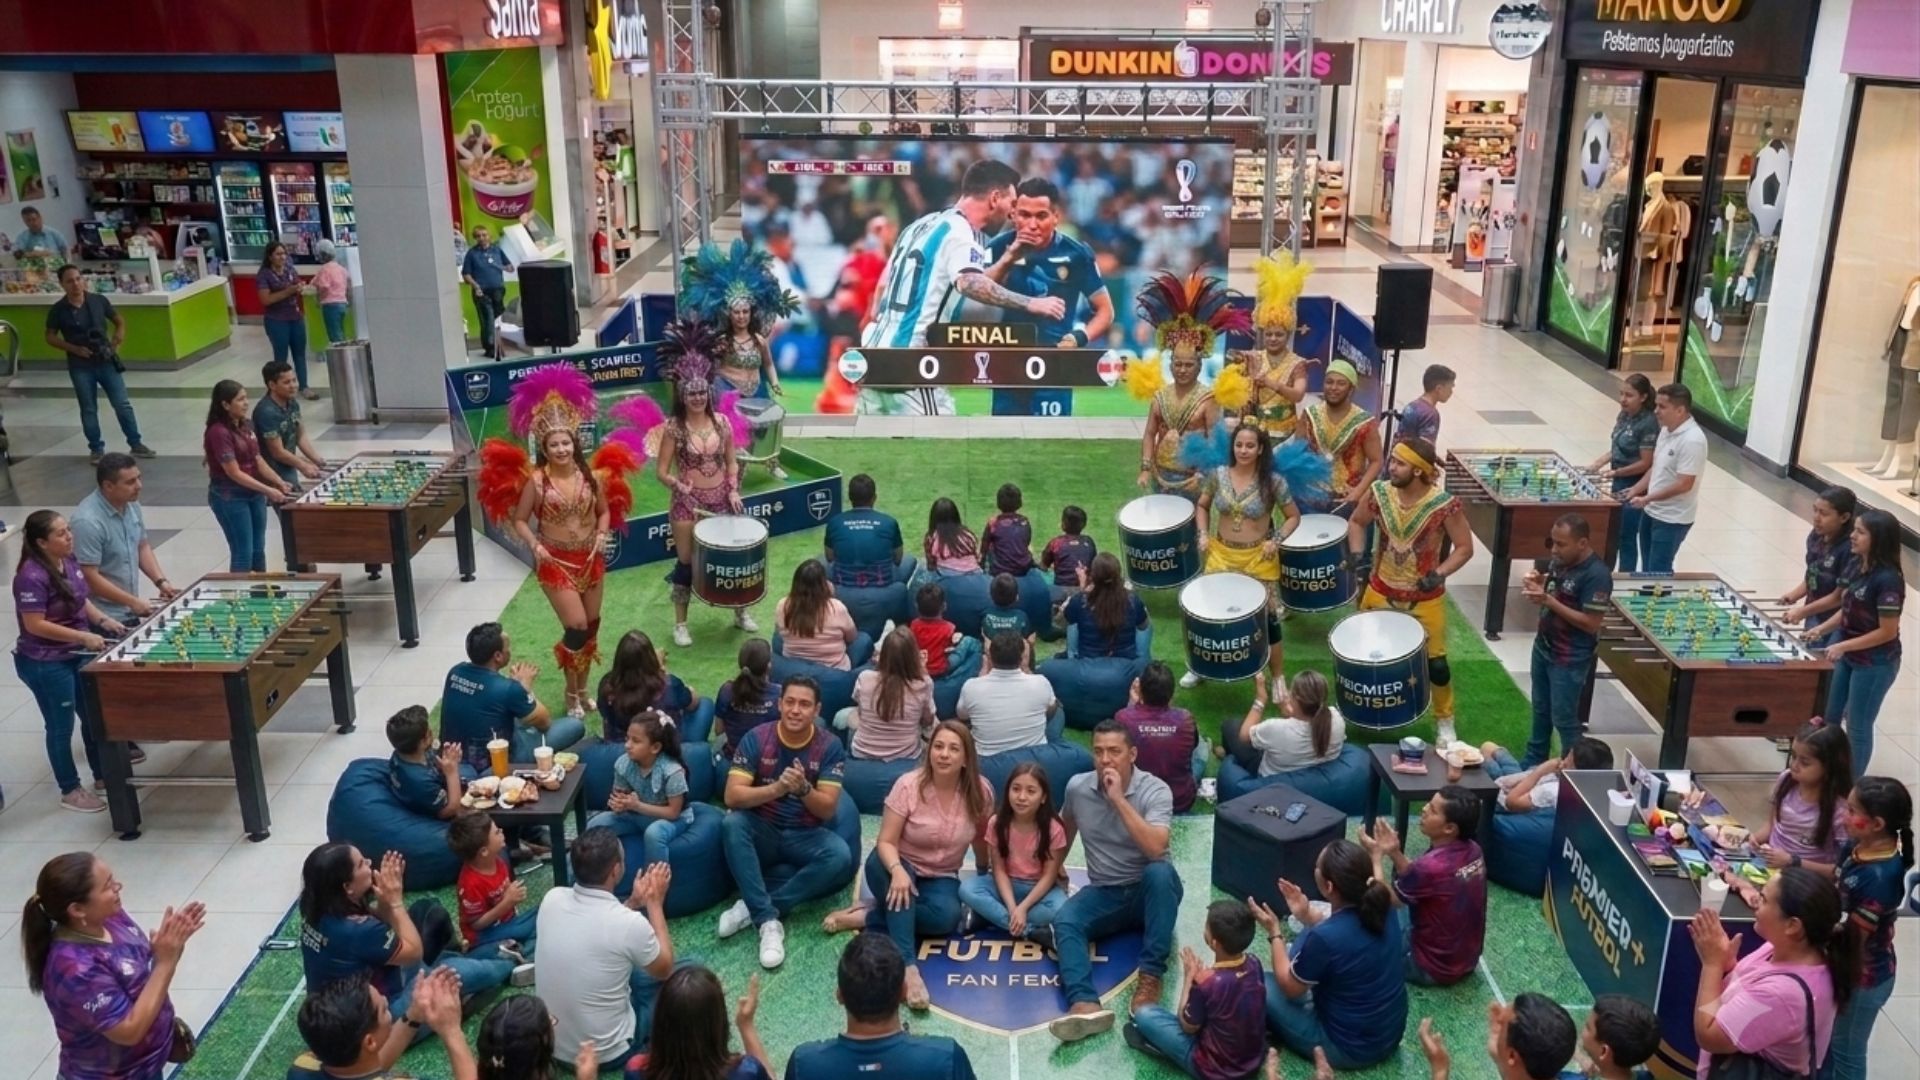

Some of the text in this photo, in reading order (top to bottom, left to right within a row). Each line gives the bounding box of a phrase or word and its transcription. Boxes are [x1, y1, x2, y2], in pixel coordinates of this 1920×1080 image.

[1050, 50, 1172, 75] DUNKIN
[948, 326, 1019, 344] FINAL
[919, 355, 1046, 380] 0 0
[917, 935, 1109, 963] FÚTBL
[947, 973, 999, 988] FAN
